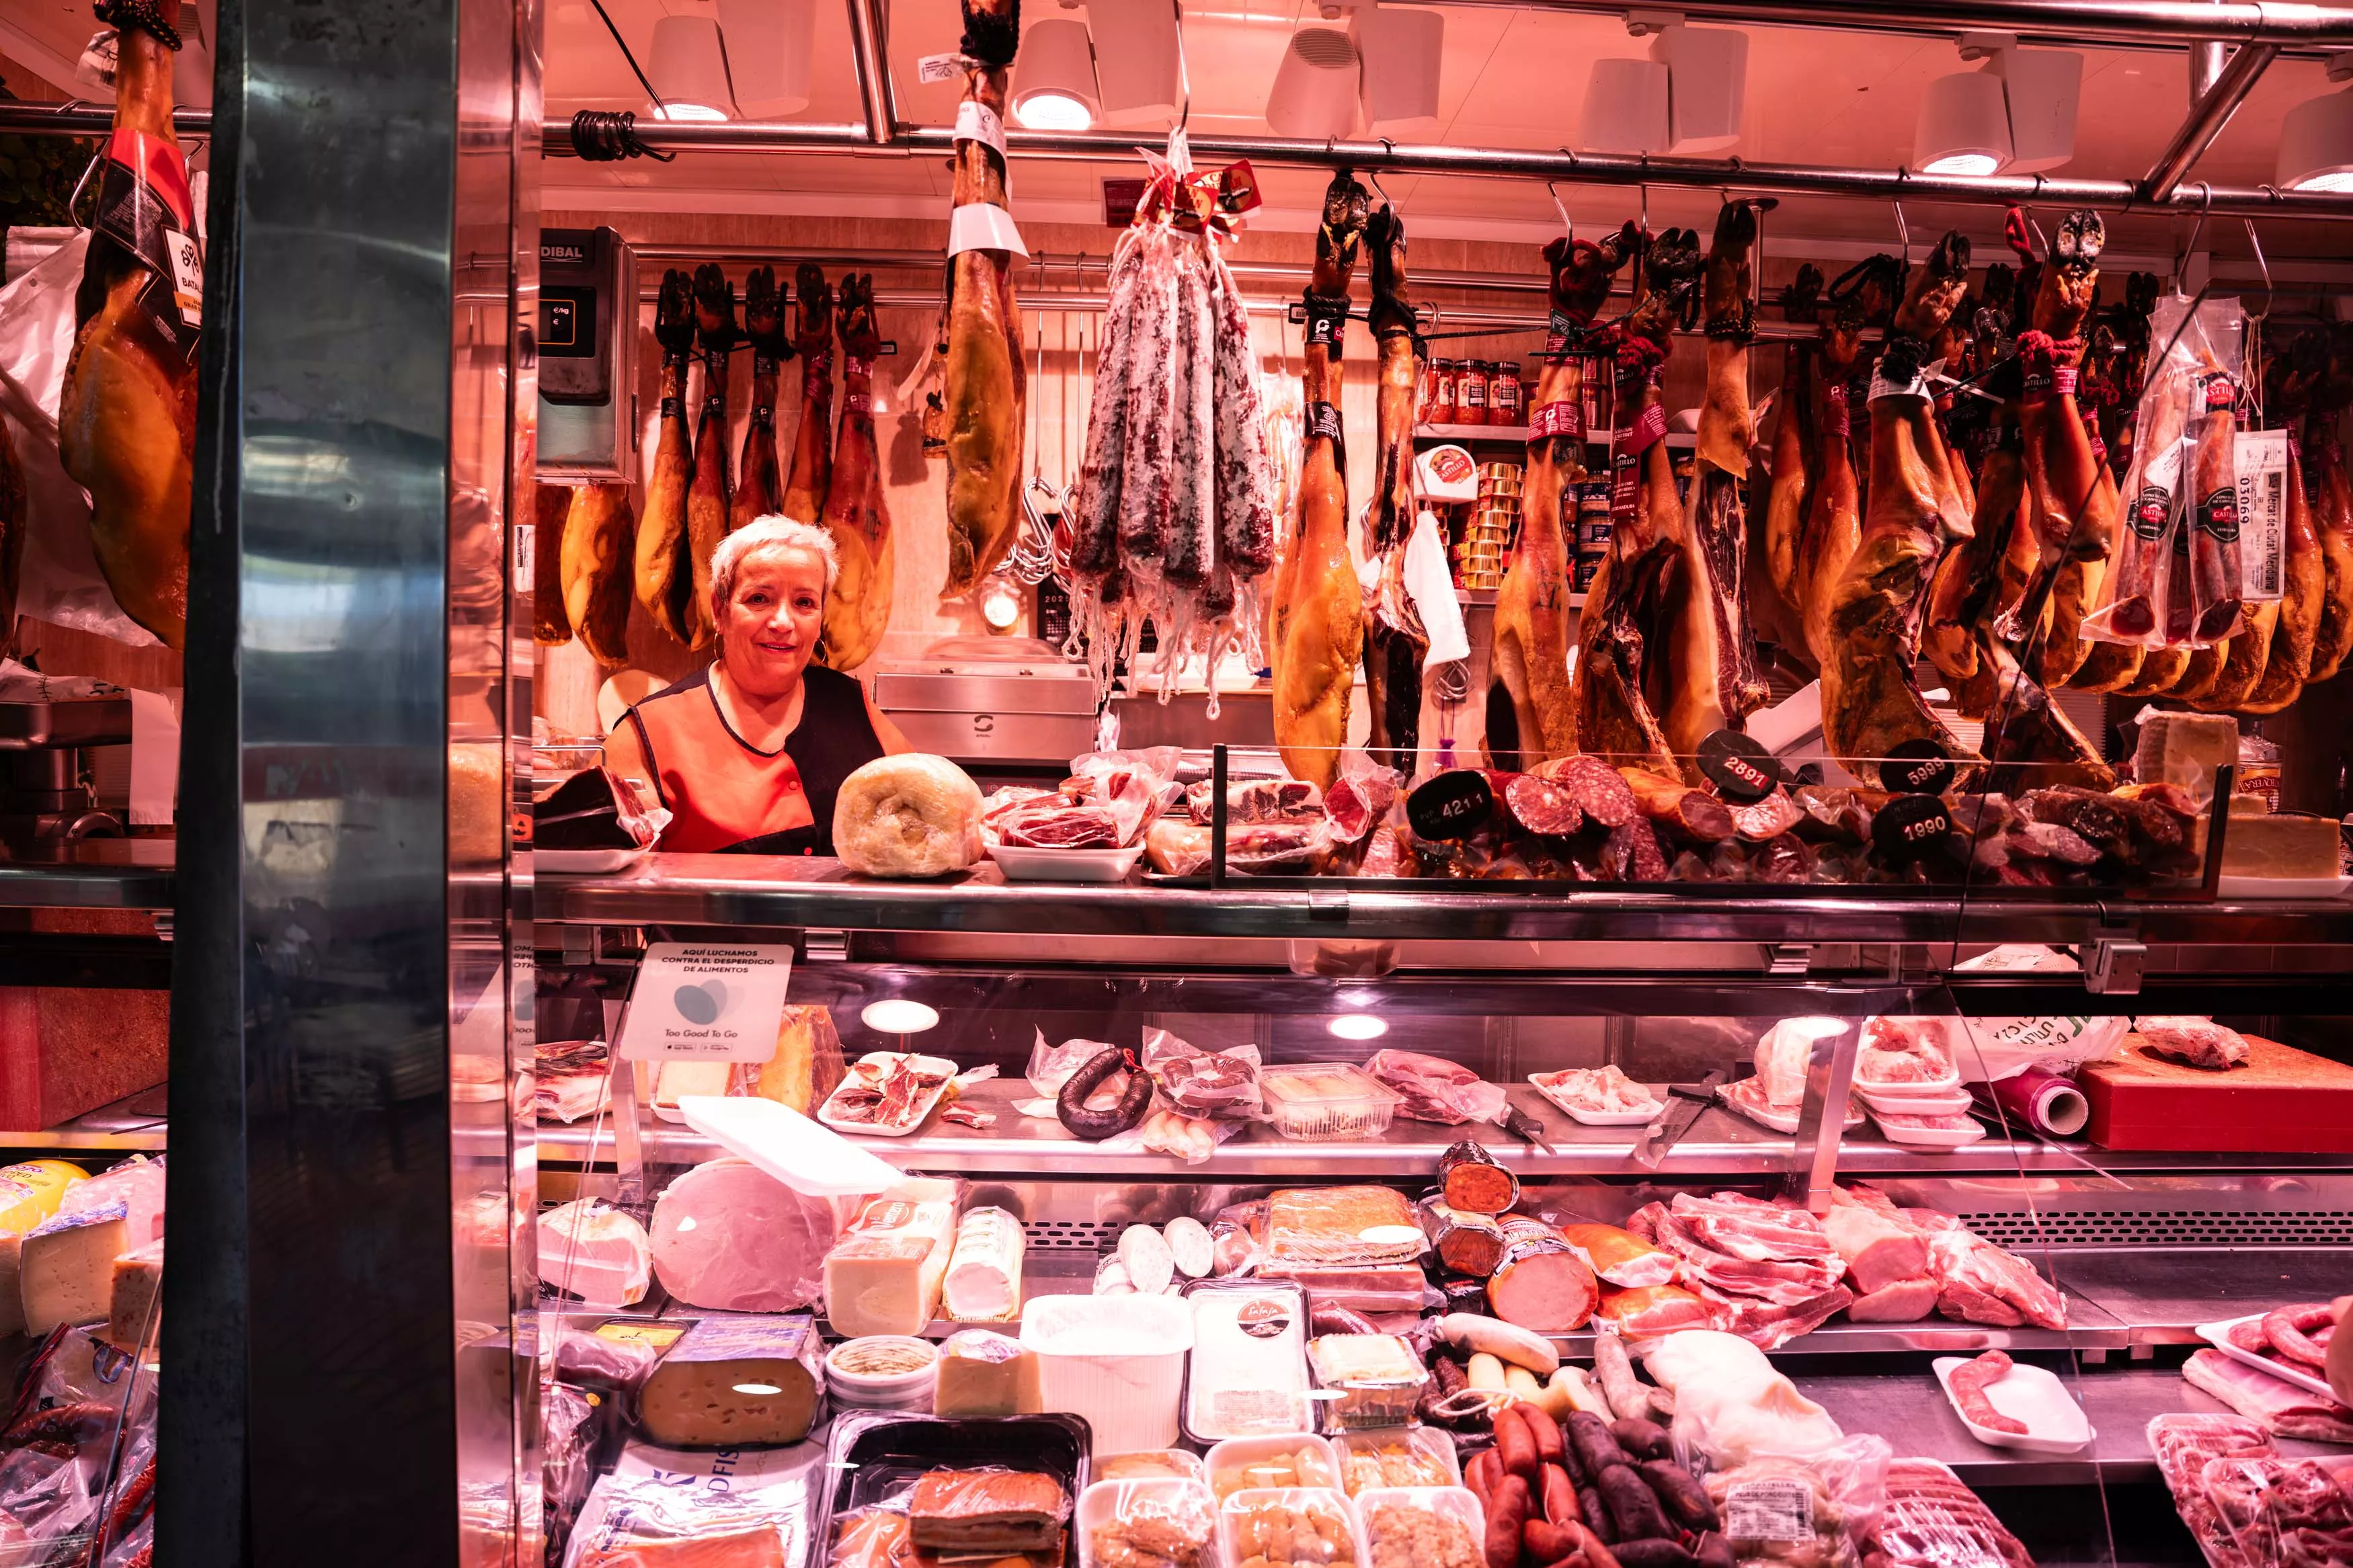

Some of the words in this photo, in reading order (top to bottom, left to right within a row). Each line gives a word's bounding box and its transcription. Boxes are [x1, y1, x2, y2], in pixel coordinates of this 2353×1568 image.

[541, 247, 583, 257] DIBAL
[2240, 477, 2250, 524] 03069
[2267, 491, 2280, 518] Mercat
[2266, 519, 2276, 527] de
[2265, 552, 2279, 590] Meridiana
[1724, 757, 1765, 787] 2891
[1907, 757, 1945, 785] 5999
[1904, 816, 1946, 841] 1990
[665, 1029, 680, 1037] Too
[683, 1029, 709, 1038] Good
[712, 1030, 721, 1038] To
[724, 1030, 738, 1038] Go
